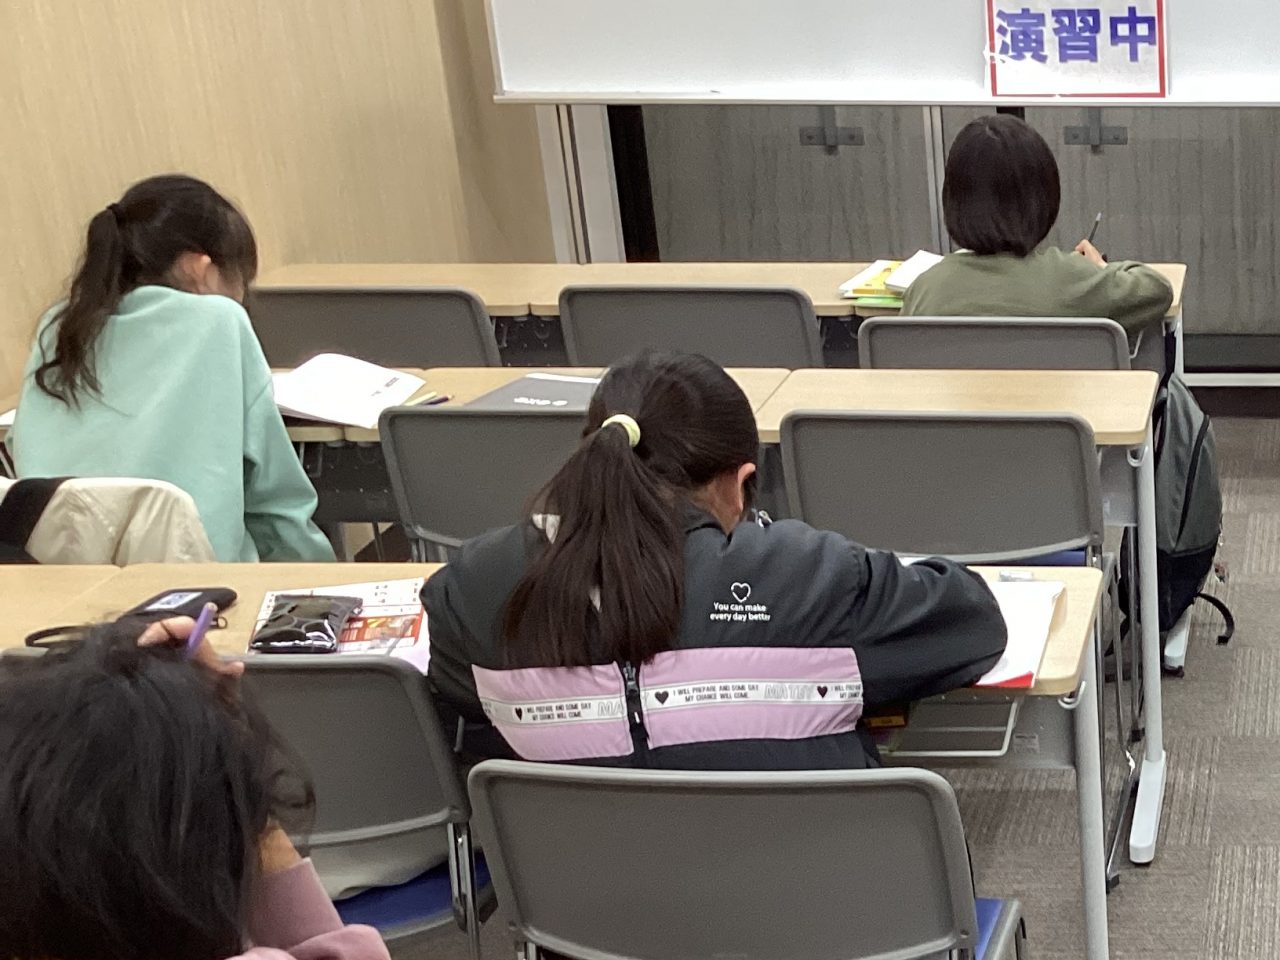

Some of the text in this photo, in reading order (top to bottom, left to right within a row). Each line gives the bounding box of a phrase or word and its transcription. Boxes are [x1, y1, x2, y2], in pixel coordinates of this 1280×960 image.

[996, 6, 1157, 63] 演習中
[713, 601, 767, 612] You can make
[709, 612, 732, 622] every
[732, 612, 747, 622] day
